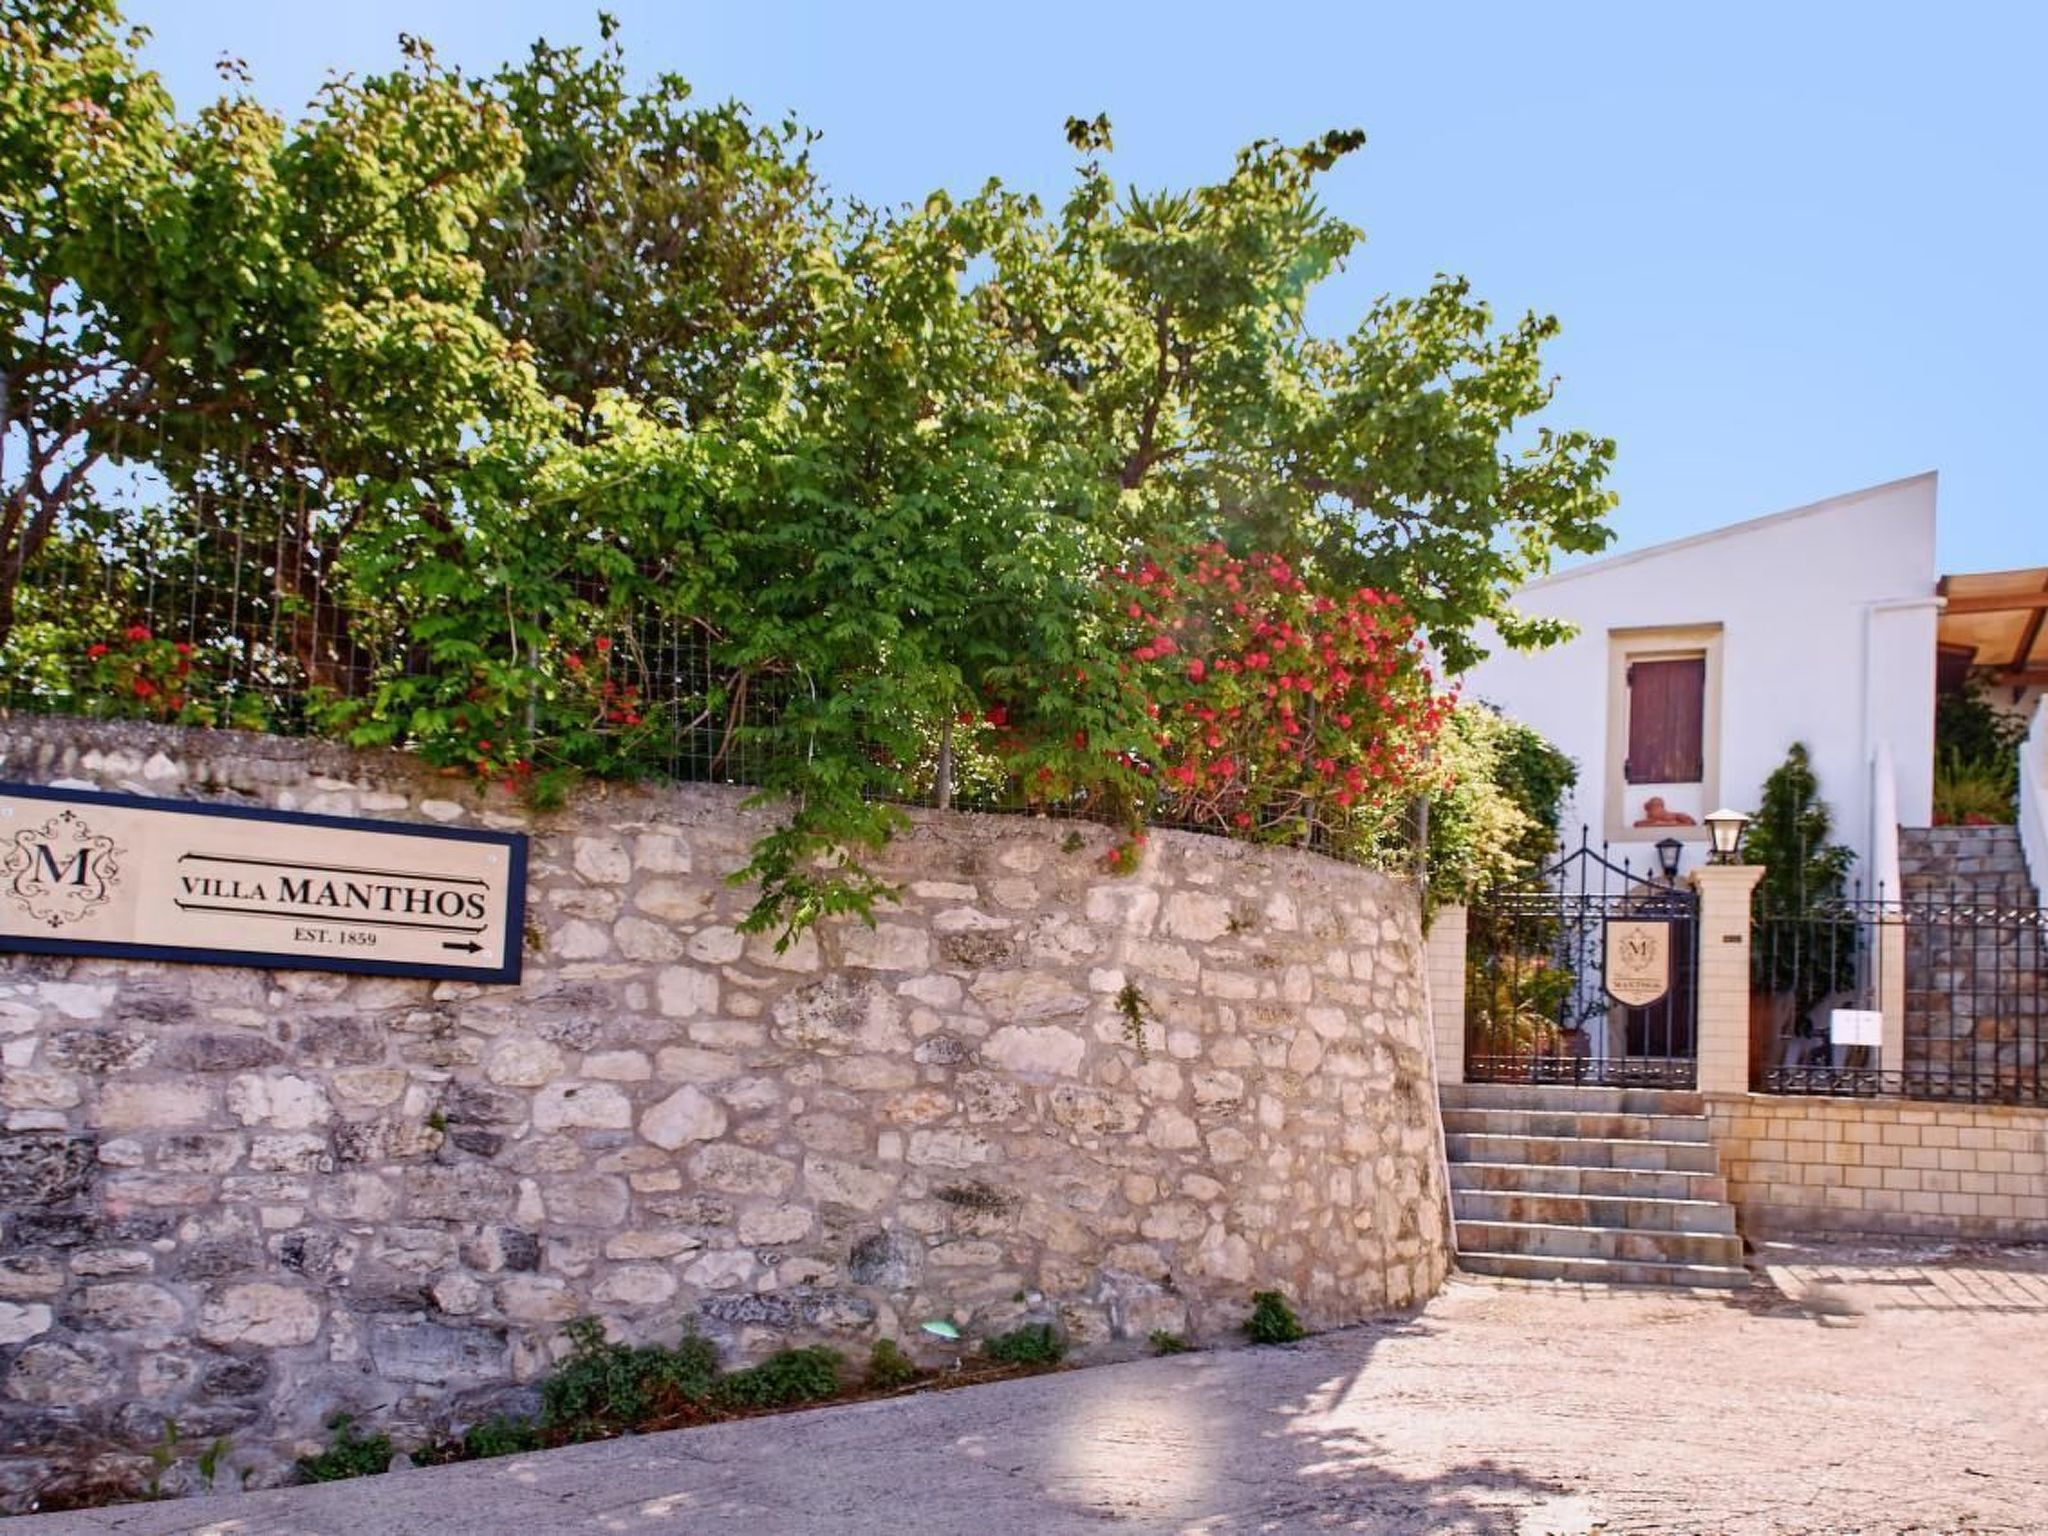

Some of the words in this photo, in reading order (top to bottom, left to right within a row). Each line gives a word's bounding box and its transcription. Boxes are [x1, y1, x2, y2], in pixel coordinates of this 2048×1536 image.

[33, 844, 92, 886] M
[181, 876, 267, 902] VILLA
[278, 877, 487, 920] MANTHOS
[293, 927, 333, 944] EST.
[339, 931, 377, 947] 1859
[1626, 941, 1647, 956] M
